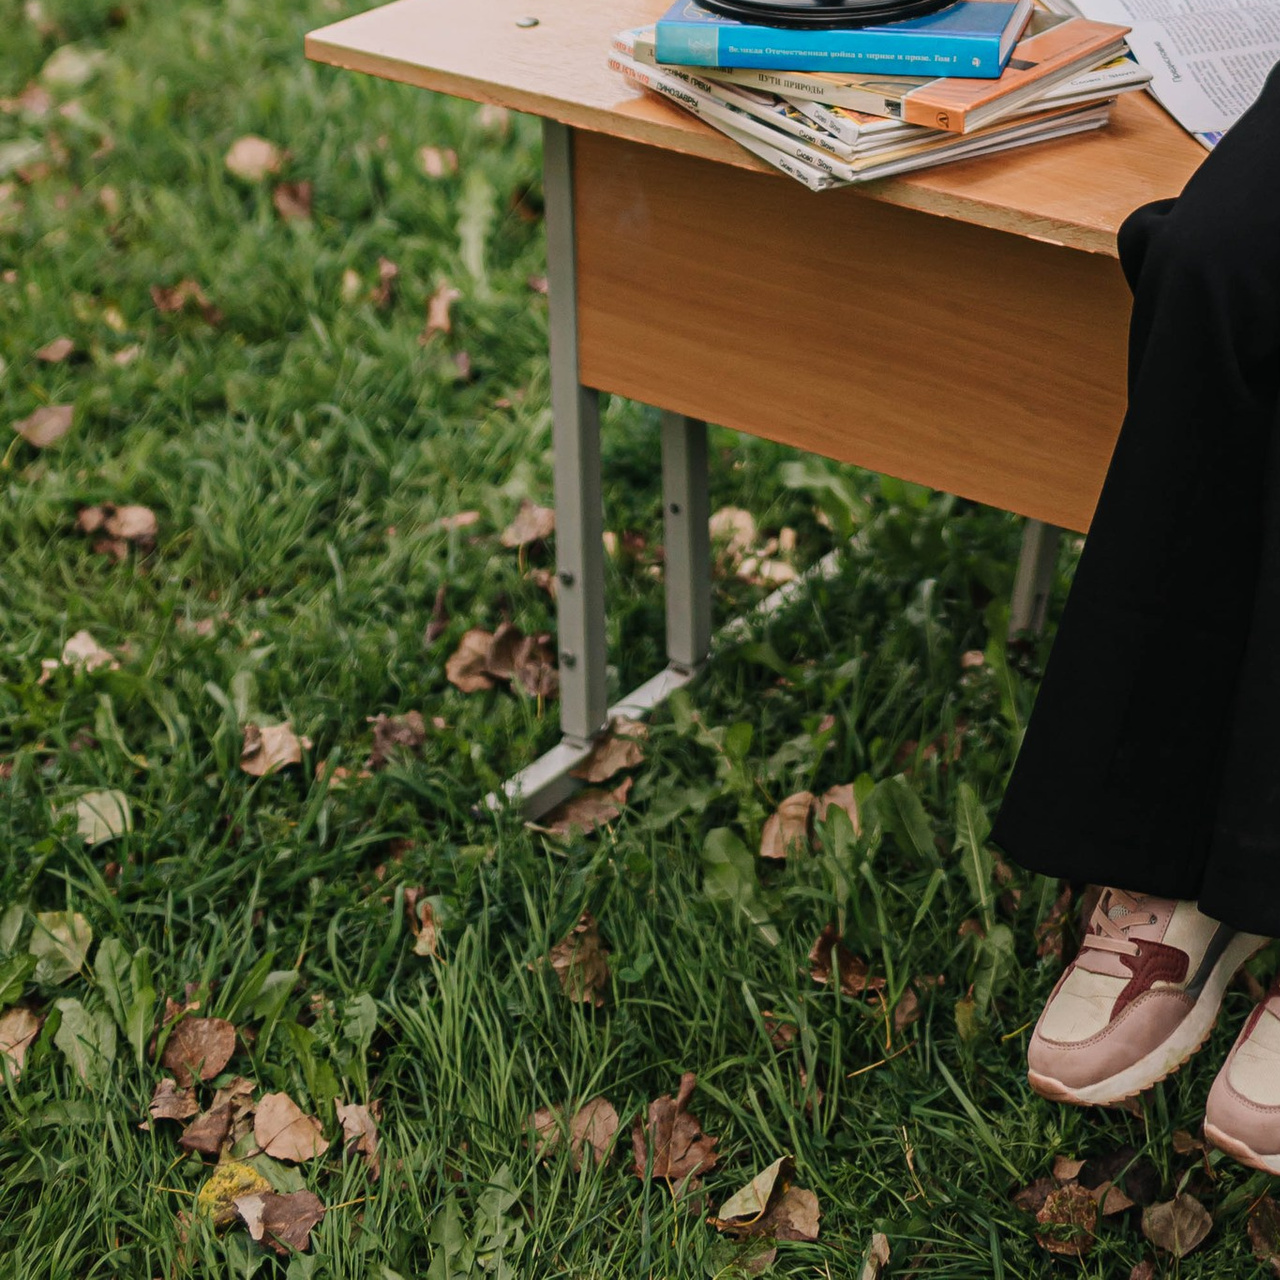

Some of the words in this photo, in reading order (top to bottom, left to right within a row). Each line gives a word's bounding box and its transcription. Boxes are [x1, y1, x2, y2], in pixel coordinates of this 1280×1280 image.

[728, 45, 763, 54] Великая
[765, 47, 828, 57] Отечественная
[830, 50, 856, 58] война
[690, 77, 711, 94] ГРЕКИ
[758, 73, 781, 87] ПУТИ
[783, 80, 824, 96] ПРИРОДЫ
[657, 83, 699, 107] ДИНОЗАВРЫ
